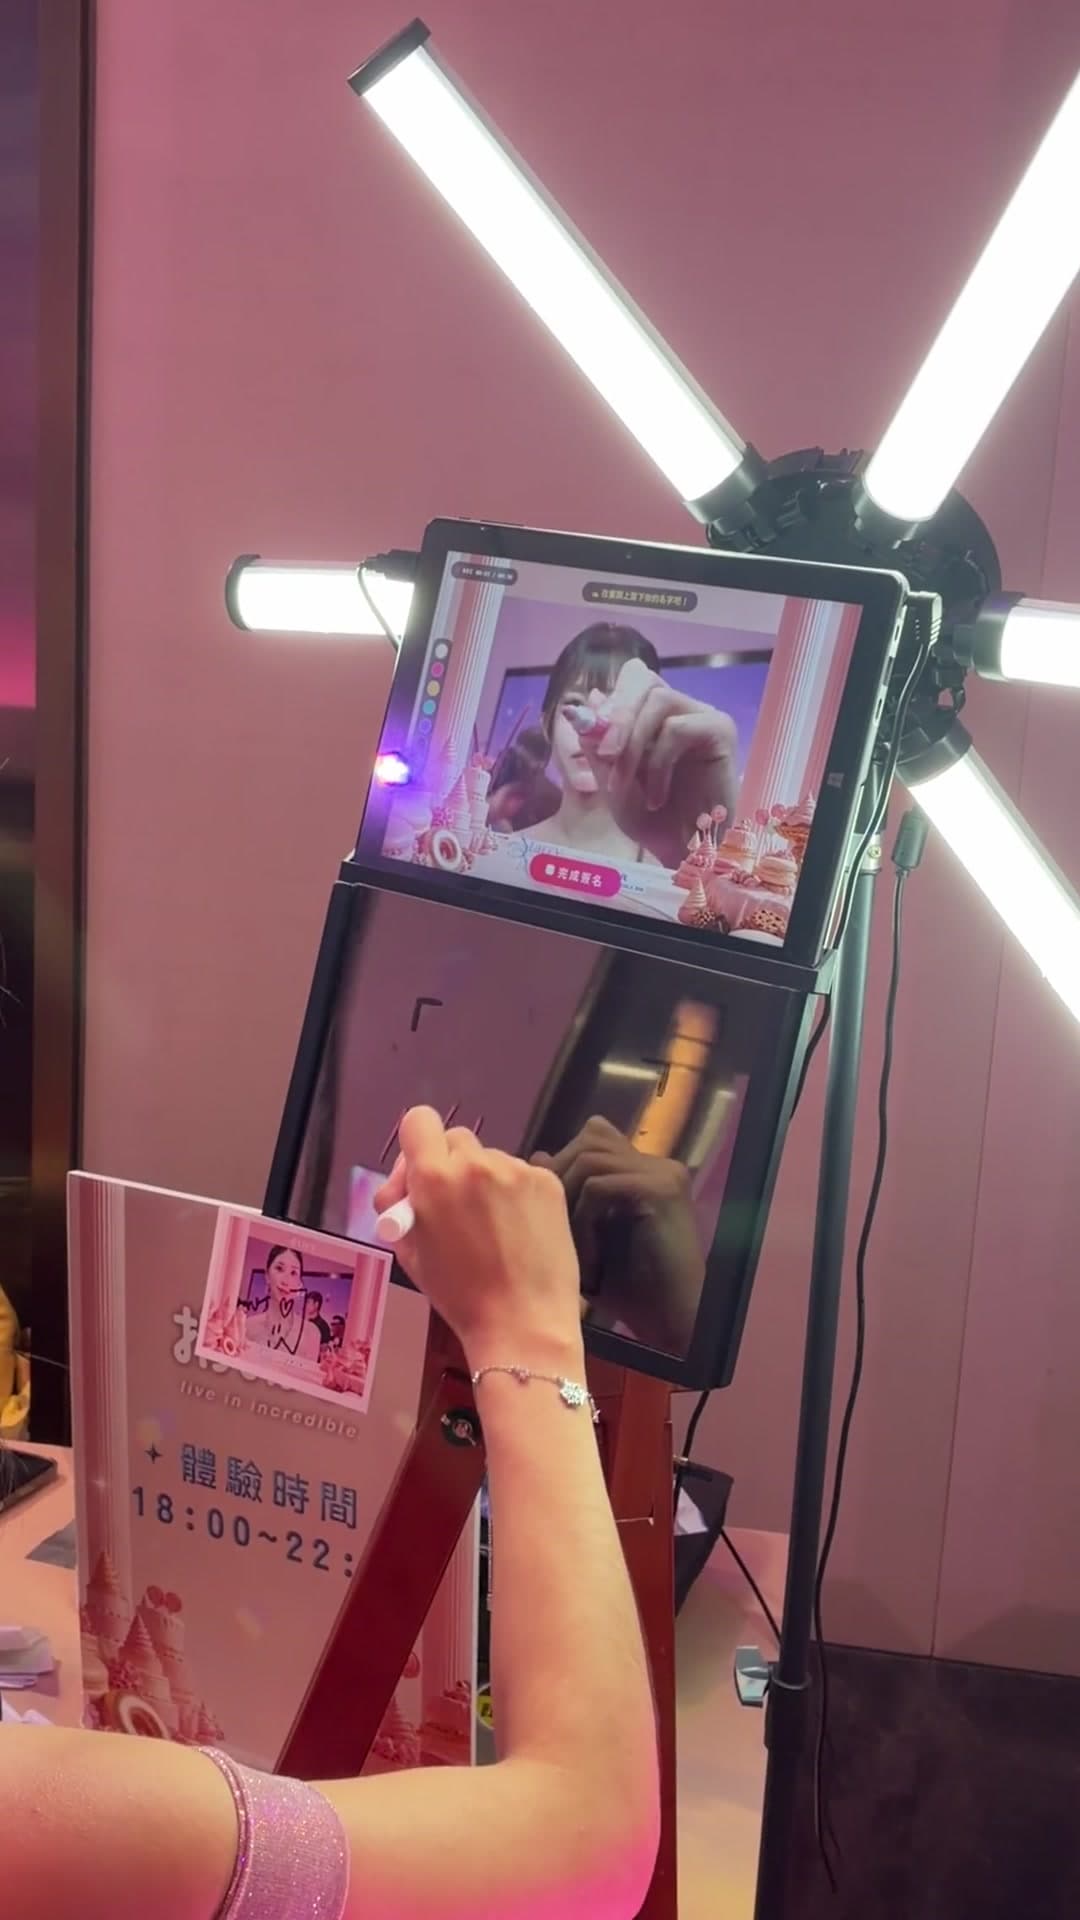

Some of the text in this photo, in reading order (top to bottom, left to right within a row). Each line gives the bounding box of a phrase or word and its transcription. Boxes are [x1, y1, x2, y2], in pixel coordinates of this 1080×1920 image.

[180, 1379, 216, 1401] live
[224, 1392, 241, 1409] in
[181, 1443, 357, 1529] 體驗時間
